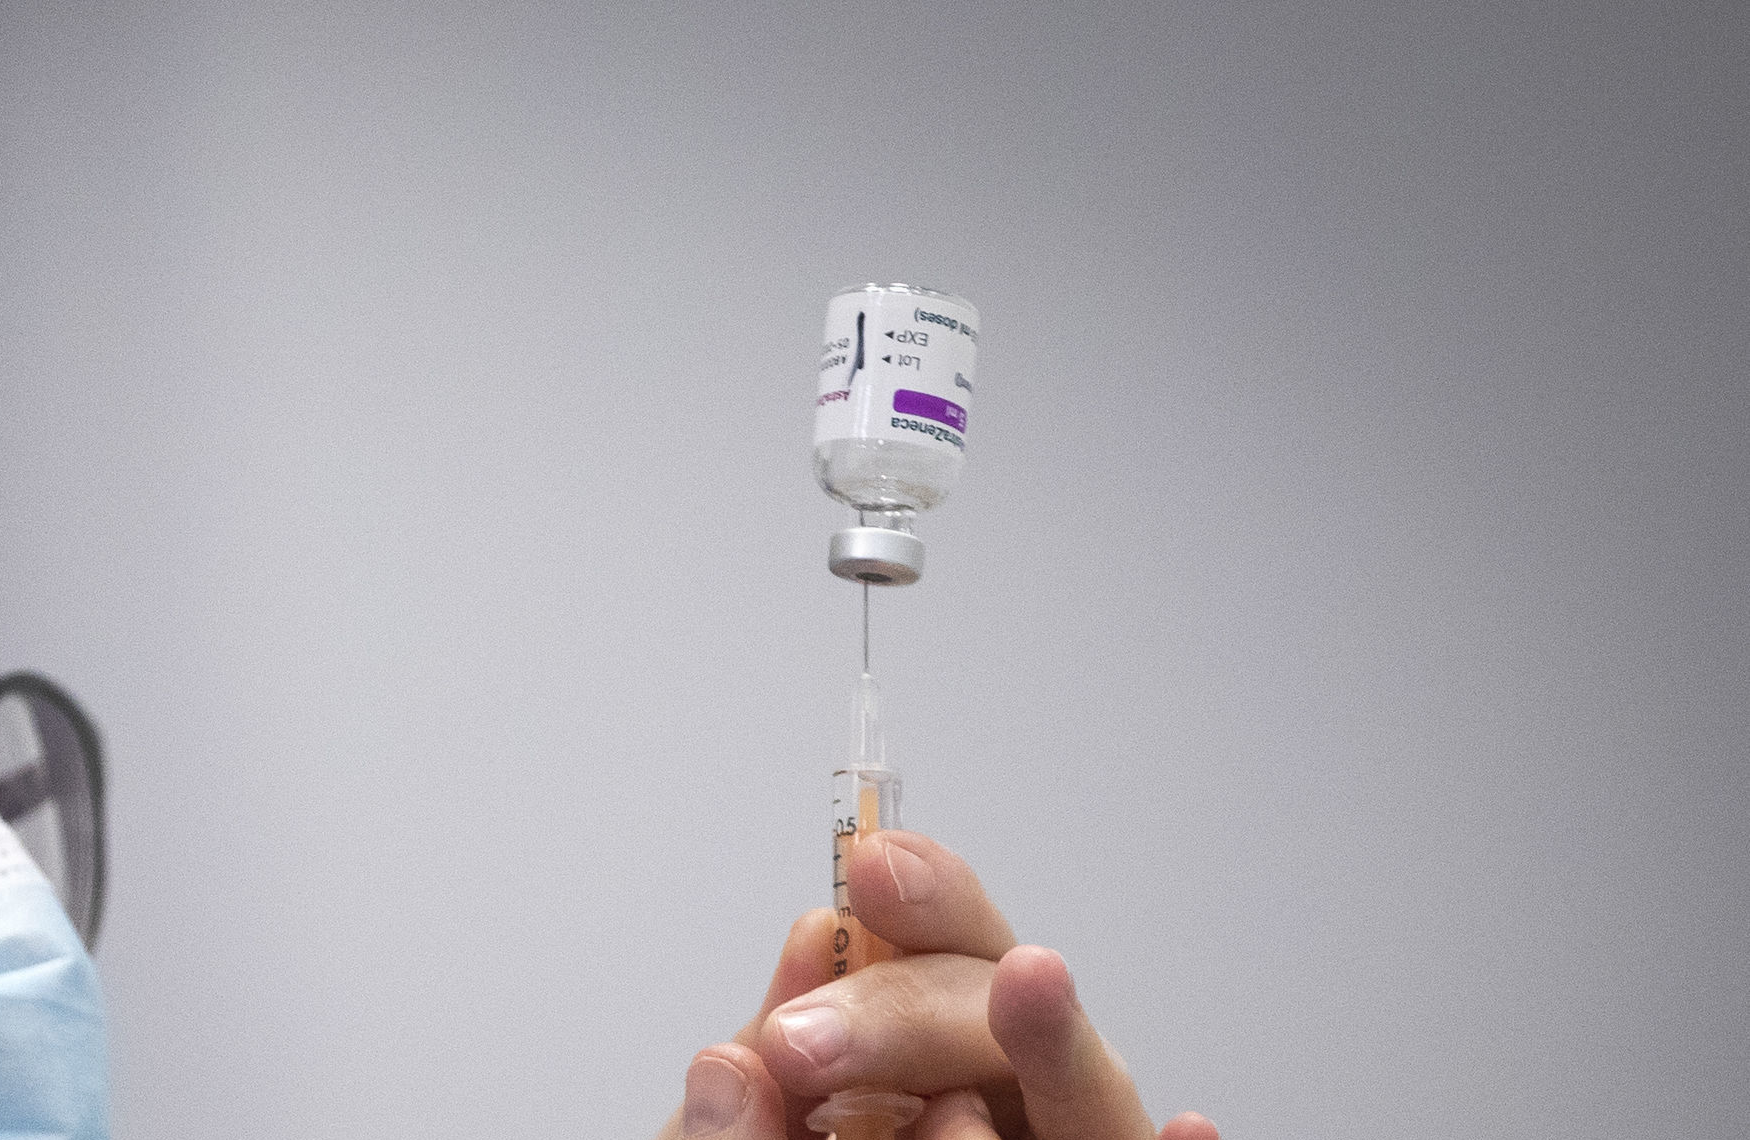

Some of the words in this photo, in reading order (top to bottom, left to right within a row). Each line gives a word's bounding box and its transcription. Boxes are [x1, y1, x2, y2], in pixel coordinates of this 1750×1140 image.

[914, 307, 958, 332] doses)
[896, 329, 929, 347] EXP
[898, 354, 921, 371] Lot
